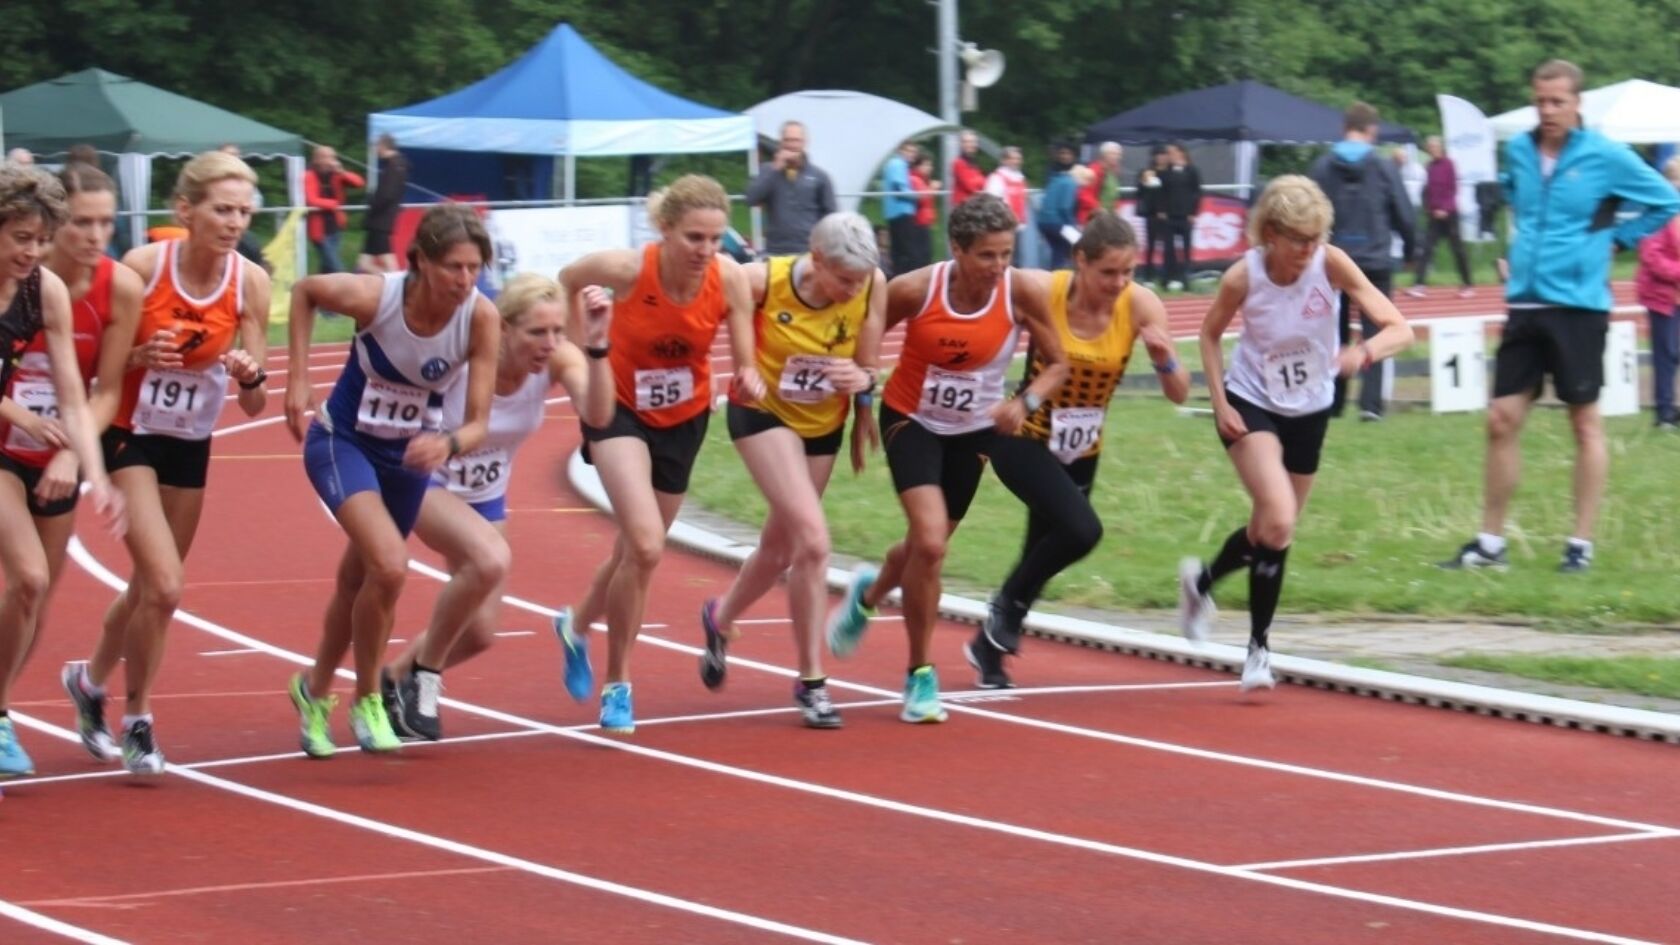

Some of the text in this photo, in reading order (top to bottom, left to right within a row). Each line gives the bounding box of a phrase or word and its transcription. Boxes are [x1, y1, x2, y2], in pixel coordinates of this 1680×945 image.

[793, 368, 828, 392] 42
[1278, 360, 1308, 389] 15
[1443, 354, 1461, 388] 1
[149, 378, 198, 411] 191
[650, 380, 681, 407] 55
[928, 384, 973, 412] 192
[368, 397, 419, 422] 110
[456, 461, 501, 489] 126
